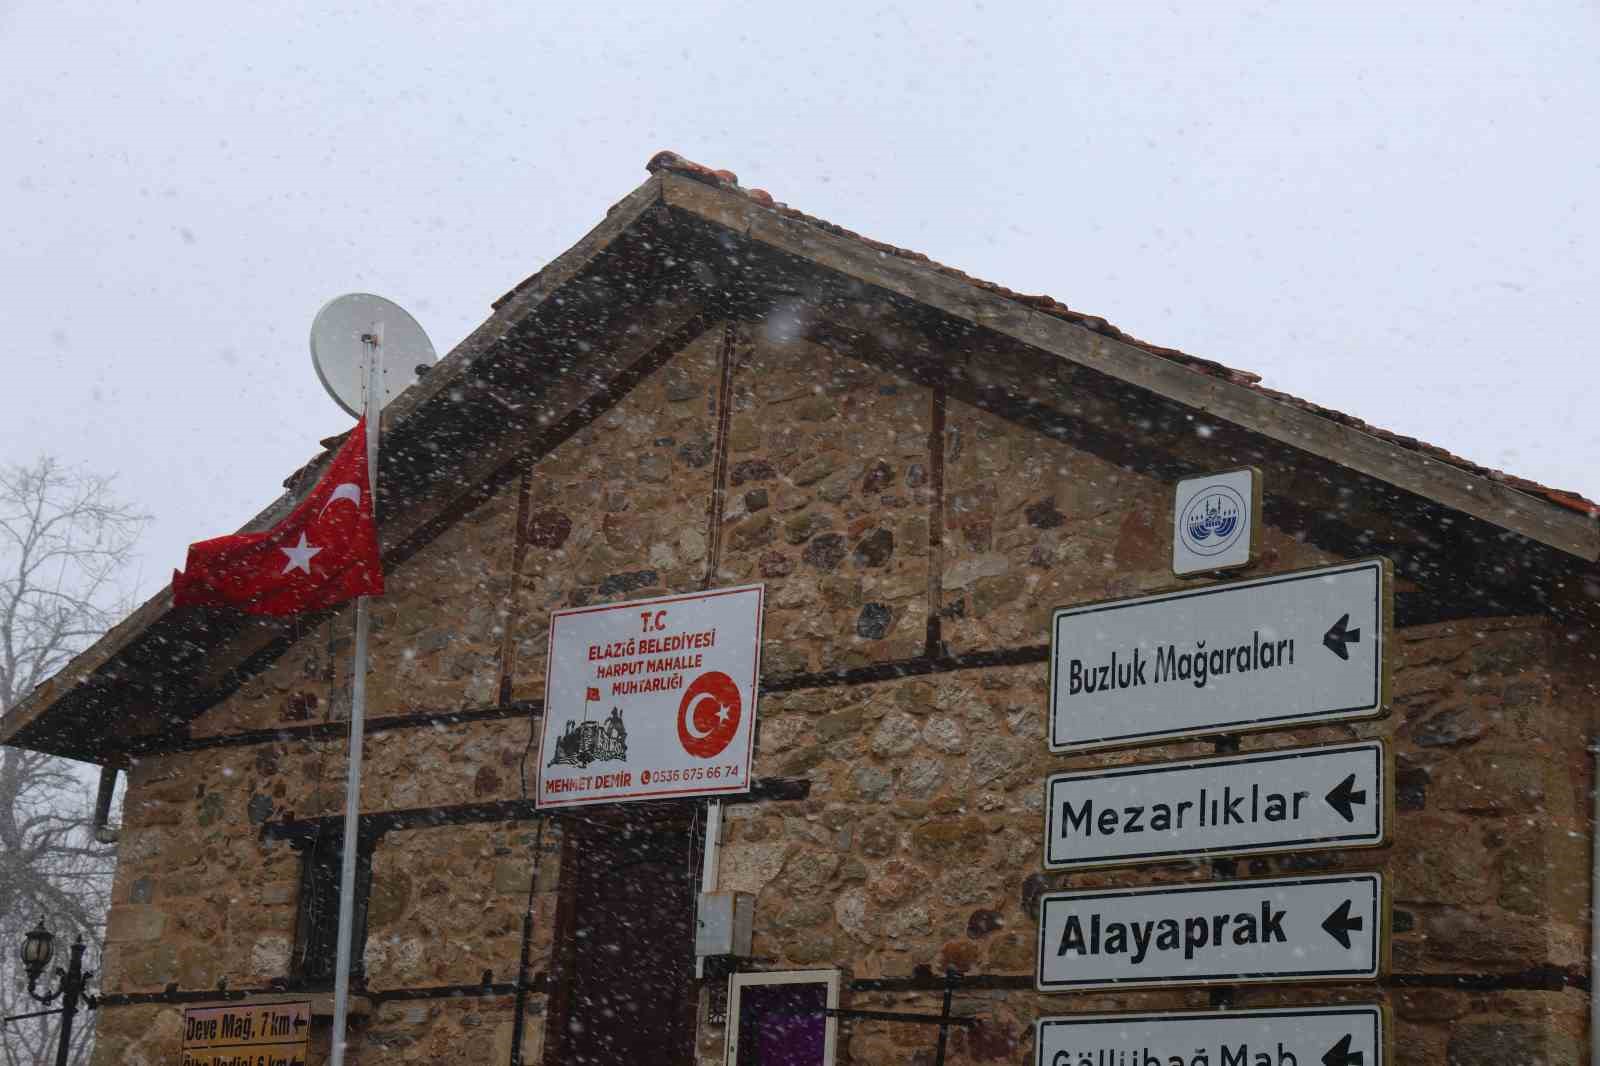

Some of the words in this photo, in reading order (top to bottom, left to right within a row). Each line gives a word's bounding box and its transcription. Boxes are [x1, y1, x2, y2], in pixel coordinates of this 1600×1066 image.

[639, 628, 716, 655] BELEDİYESİ
[597, 661, 644, 679] HARPUT
[647, 654, 702, 673] MAHALLE
[1069, 649, 1146, 695] Buzluk
[1154, 631, 1294, 688] Mağaraları
[612, 673, 683, 696] MUHTARLIĞI
[546, 775, 592, 793] MEHMET
[594, 770, 631, 789] DEMİR
[725, 765, 738, 777] 74
[1061, 784, 1310, 839] Mezarlıklar
[1057, 900, 1287, 964] Alayaprak
[186, 1016, 217, 1040] Deve
[270, 1011, 290, 1036] km
